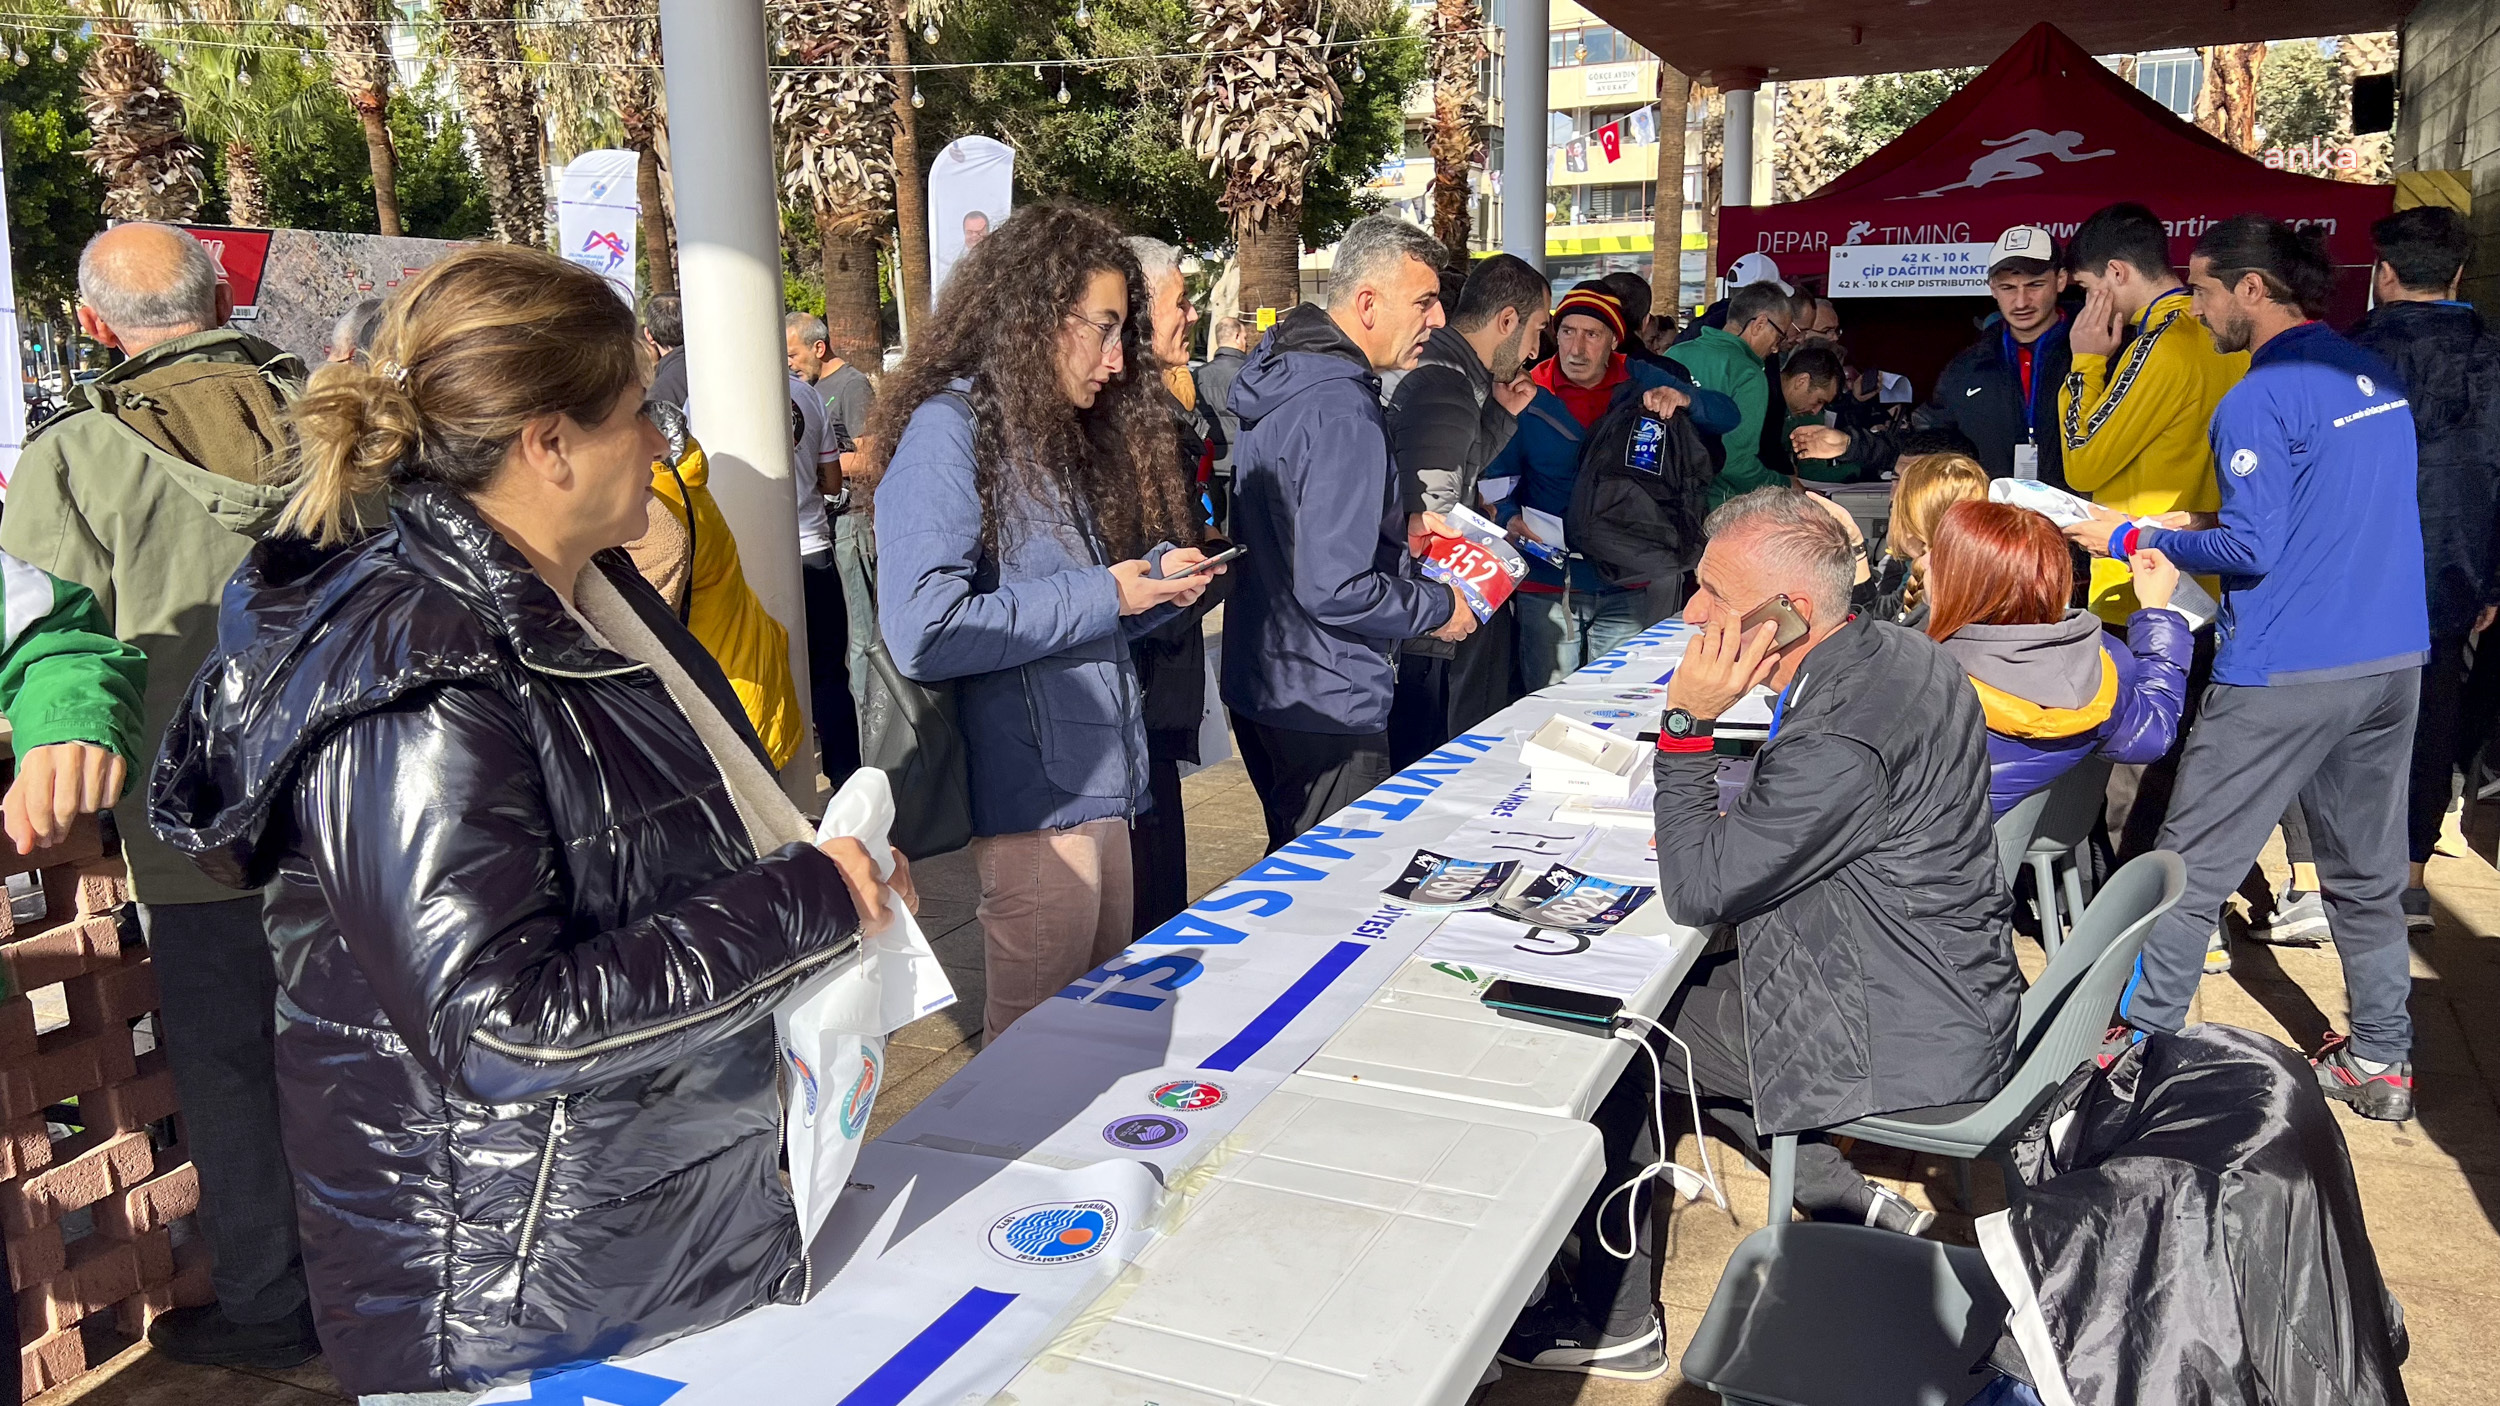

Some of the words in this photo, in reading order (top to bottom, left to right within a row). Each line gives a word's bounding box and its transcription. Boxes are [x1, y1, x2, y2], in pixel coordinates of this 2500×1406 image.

[1757, 231, 1829, 253] DEPAR
[1880, 222, 1971, 245] TIMING
[1901, 253, 1918, 263] 42
[1921, 252, 1931, 262] K
[1943, 252, 1957, 262] 10
[1960, 251, 1970, 262] K
[1862, 264, 1884, 279] ÇİP
[1888, 263, 1945, 277] DAĞITIM
[1949, 265, 1989, 276] NOKT
[1838, 280, 1850, 289] 42
[1868, 280, 1878, 288] 10
[1880, 280, 1888, 288] K
[1890, 279, 1915, 288] CHIP
[1635, 444, 1648, 452] 10
[1649, 444, 1658, 453] K
[1438, 544, 1498, 592] 352
[1471, 599, 1484, 611] 42
[1482, 605, 1493, 616] K
[1425, 866, 1490, 900] 6930
[1541, 886, 1620, 924] 6929
[996, 1216, 1016, 1229] 1873
[1015, 1252, 1085, 1263] BELEDİYESİ
